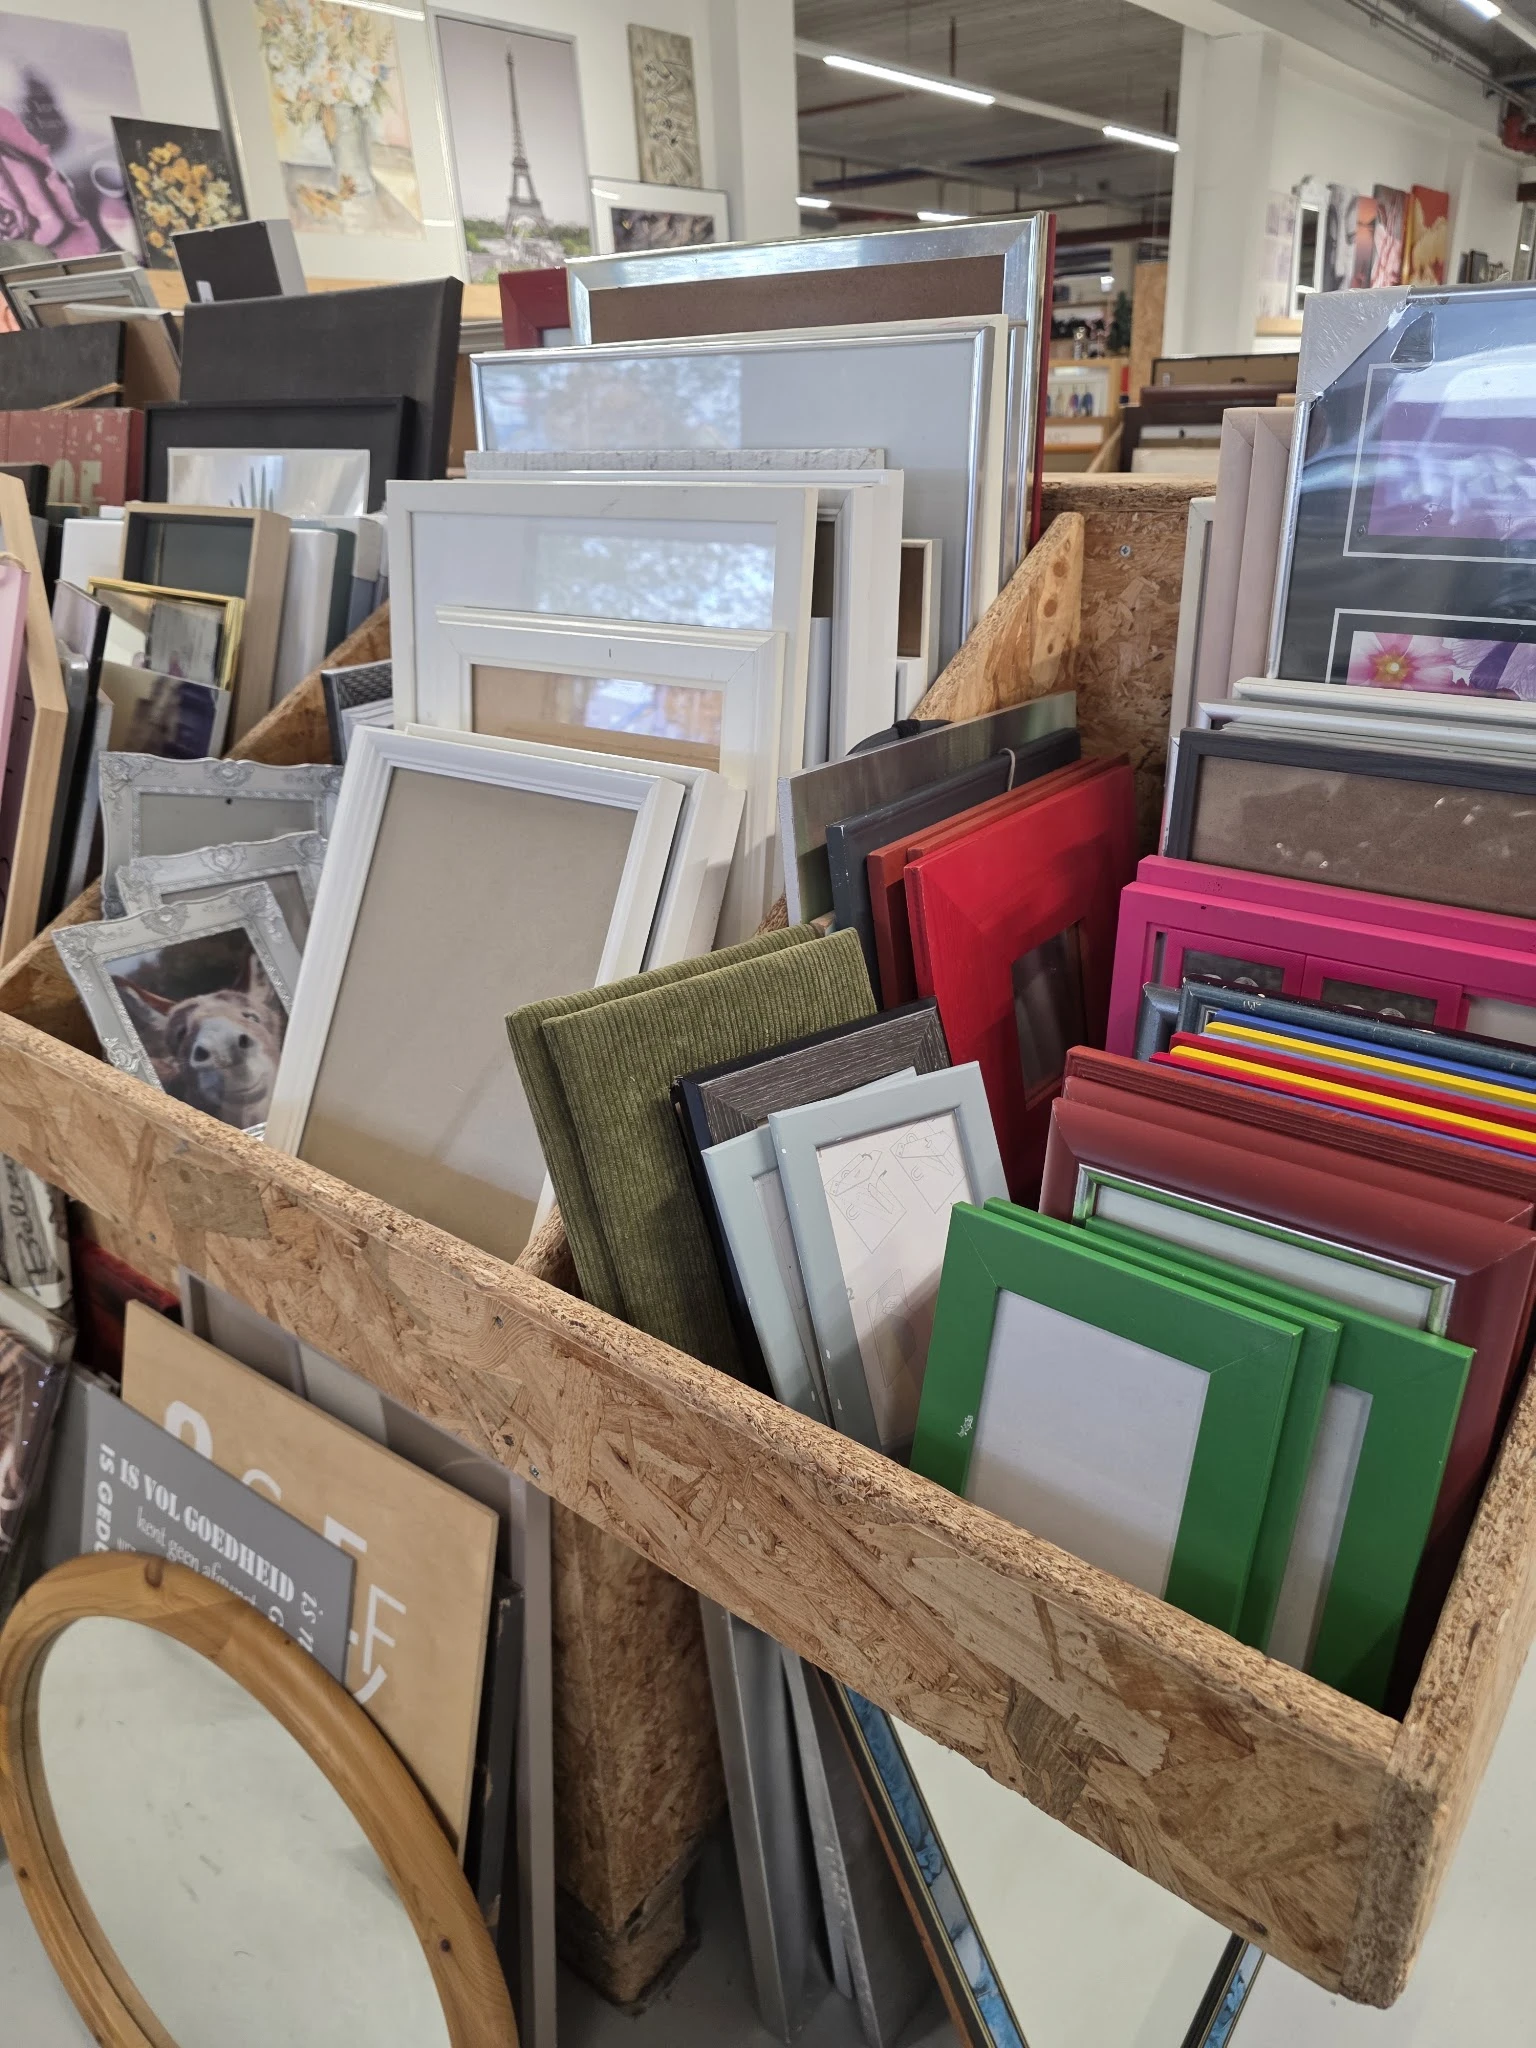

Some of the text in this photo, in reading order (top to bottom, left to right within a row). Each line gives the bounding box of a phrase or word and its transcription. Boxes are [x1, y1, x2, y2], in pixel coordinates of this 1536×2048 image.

[120, 1457, 140, 1491] IS
[143, 1474, 181, 1521] VOL
[183, 1505, 295, 1602] GOEDHEID
